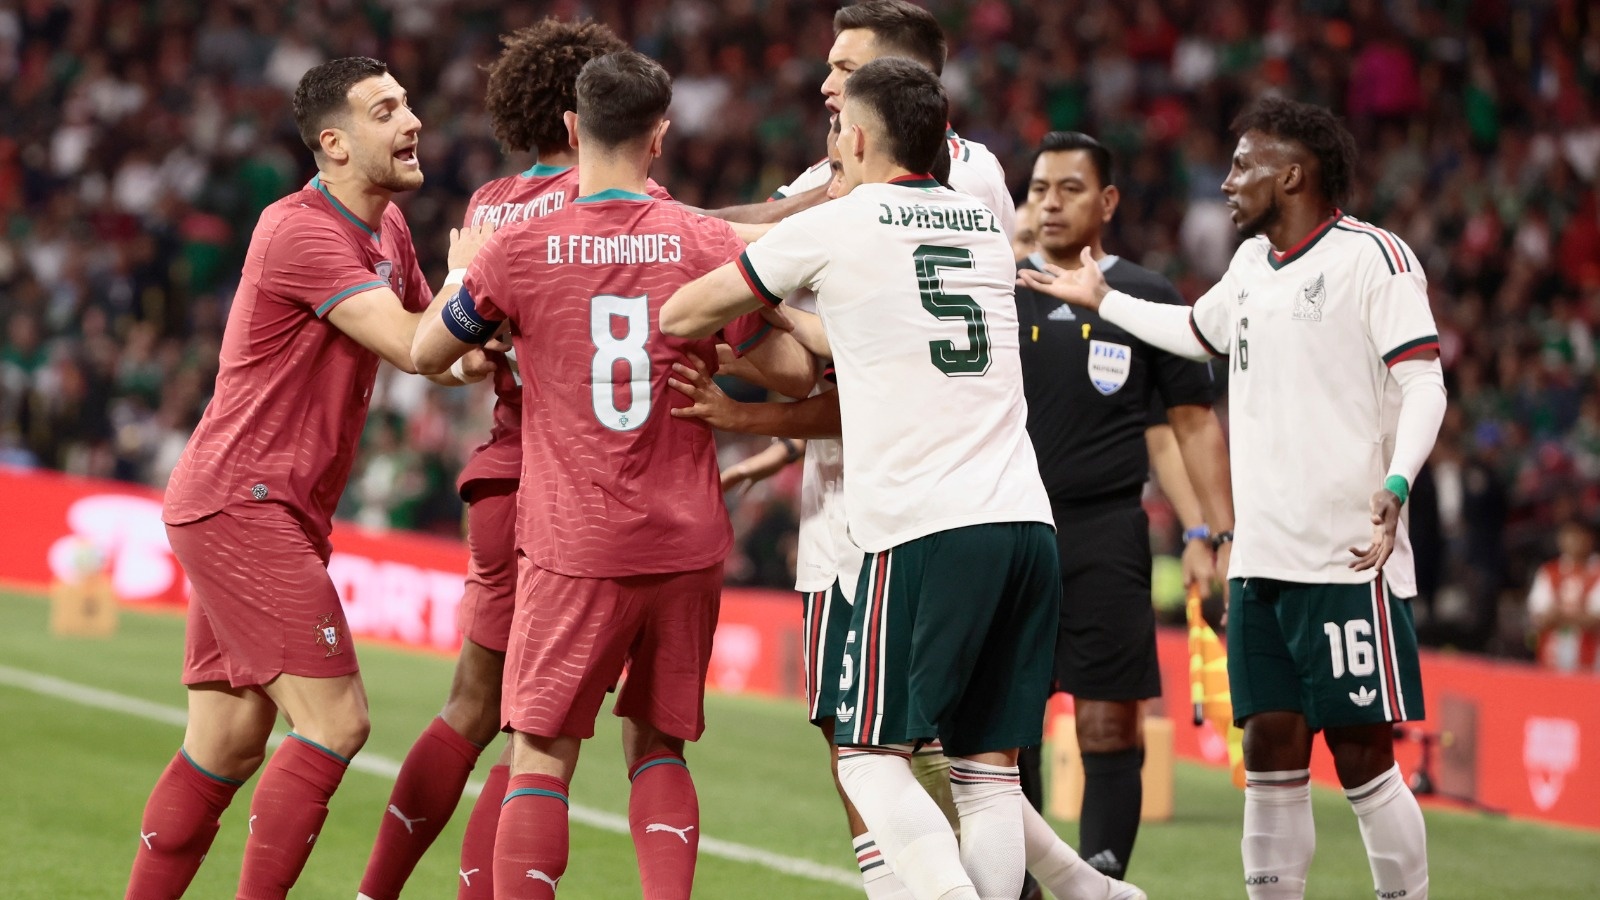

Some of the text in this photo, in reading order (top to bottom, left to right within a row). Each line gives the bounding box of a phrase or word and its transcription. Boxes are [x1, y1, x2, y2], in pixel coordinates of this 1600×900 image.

[450, 301, 483, 334] RESPECT
[912, 244, 993, 377] 5
[590, 293, 652, 432] 8
[1094, 343, 1126, 361] FIFA
[1323, 619, 1376, 679] 16
